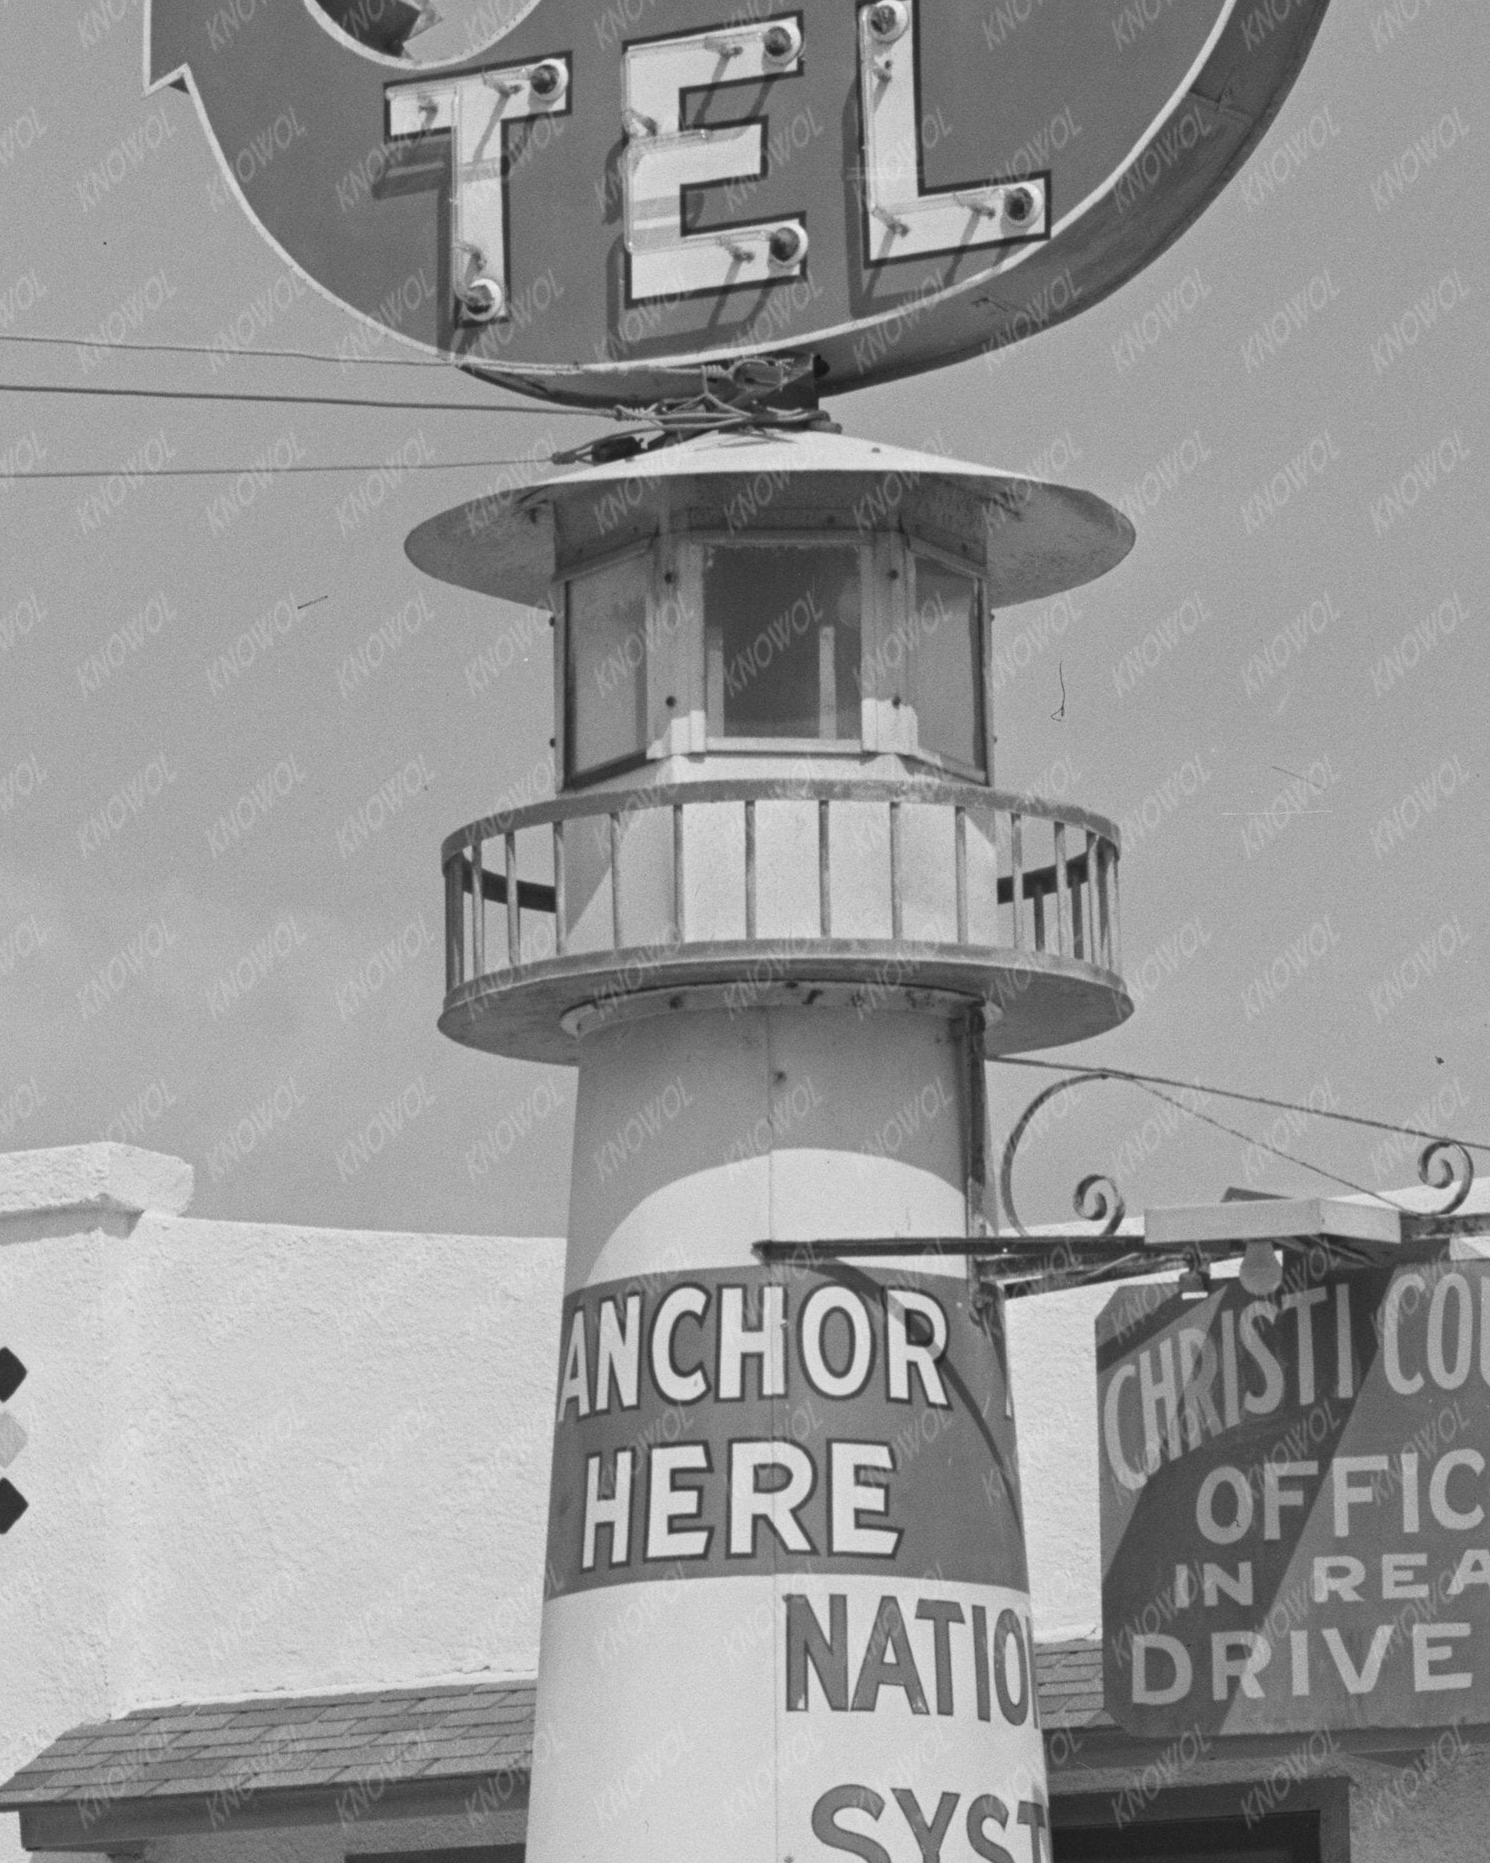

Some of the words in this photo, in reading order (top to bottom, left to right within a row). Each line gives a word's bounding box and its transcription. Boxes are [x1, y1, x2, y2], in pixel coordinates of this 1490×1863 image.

[556, 1282, 954, 1422] ANCHOR
[1105, 1283, 1353, 1490] CHRISTI
[579, 1438, 904, 1572] HERE
[1175, 1562, 1253, 1608] IN
[786, 1594, 1038, 1729] NATIO
[1132, 1622, 1472, 1705] DRIVE
